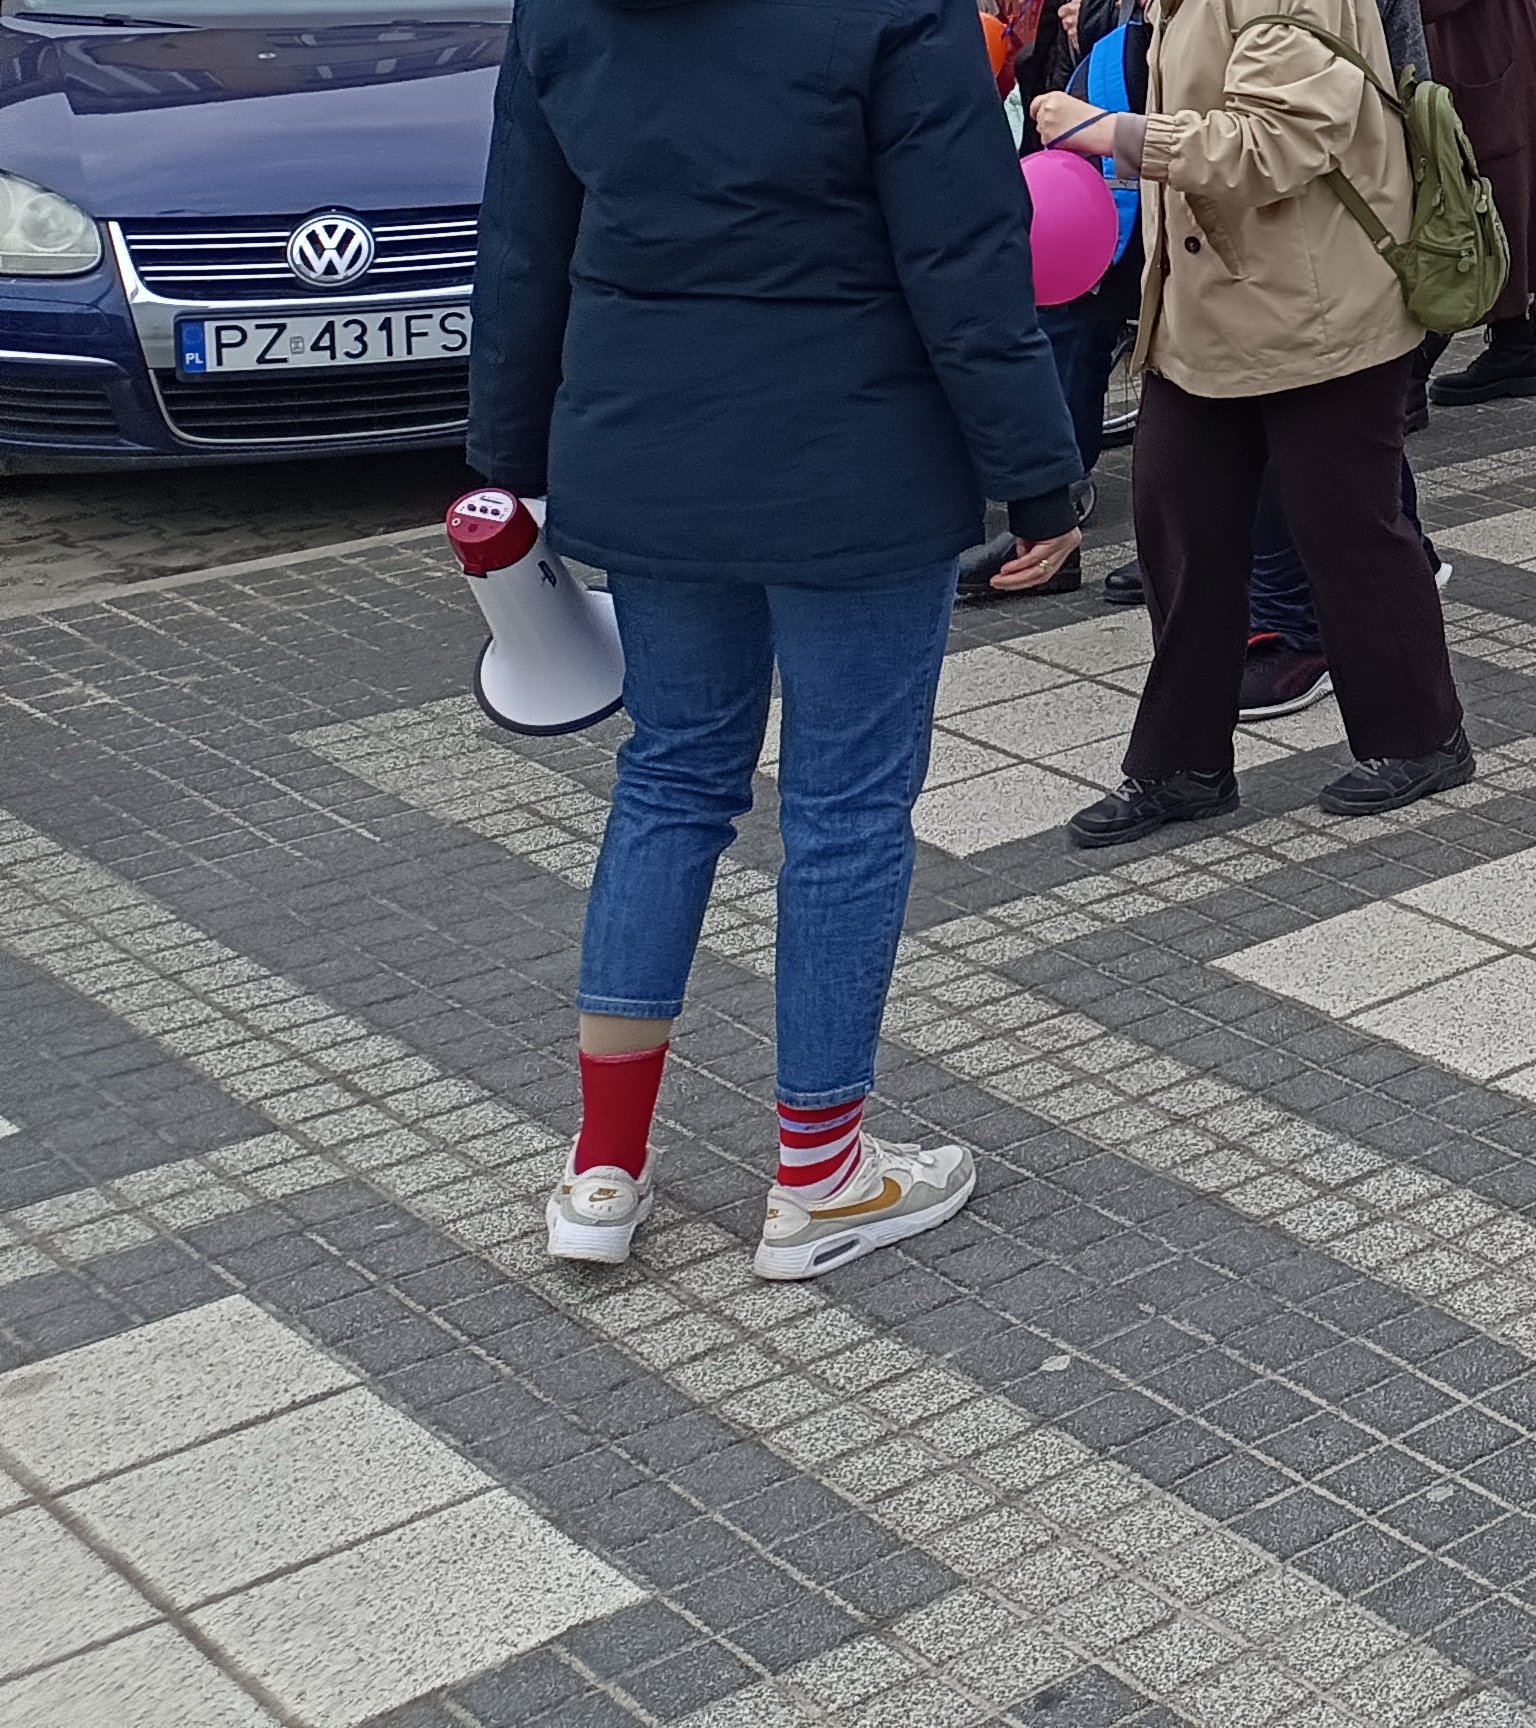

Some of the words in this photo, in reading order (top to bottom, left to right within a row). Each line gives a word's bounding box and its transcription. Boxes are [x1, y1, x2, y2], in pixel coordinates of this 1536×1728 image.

[214, 322, 289, 367] PZ
[309, 311, 469, 361] 431FS
[185, 352, 204, 365] PL
